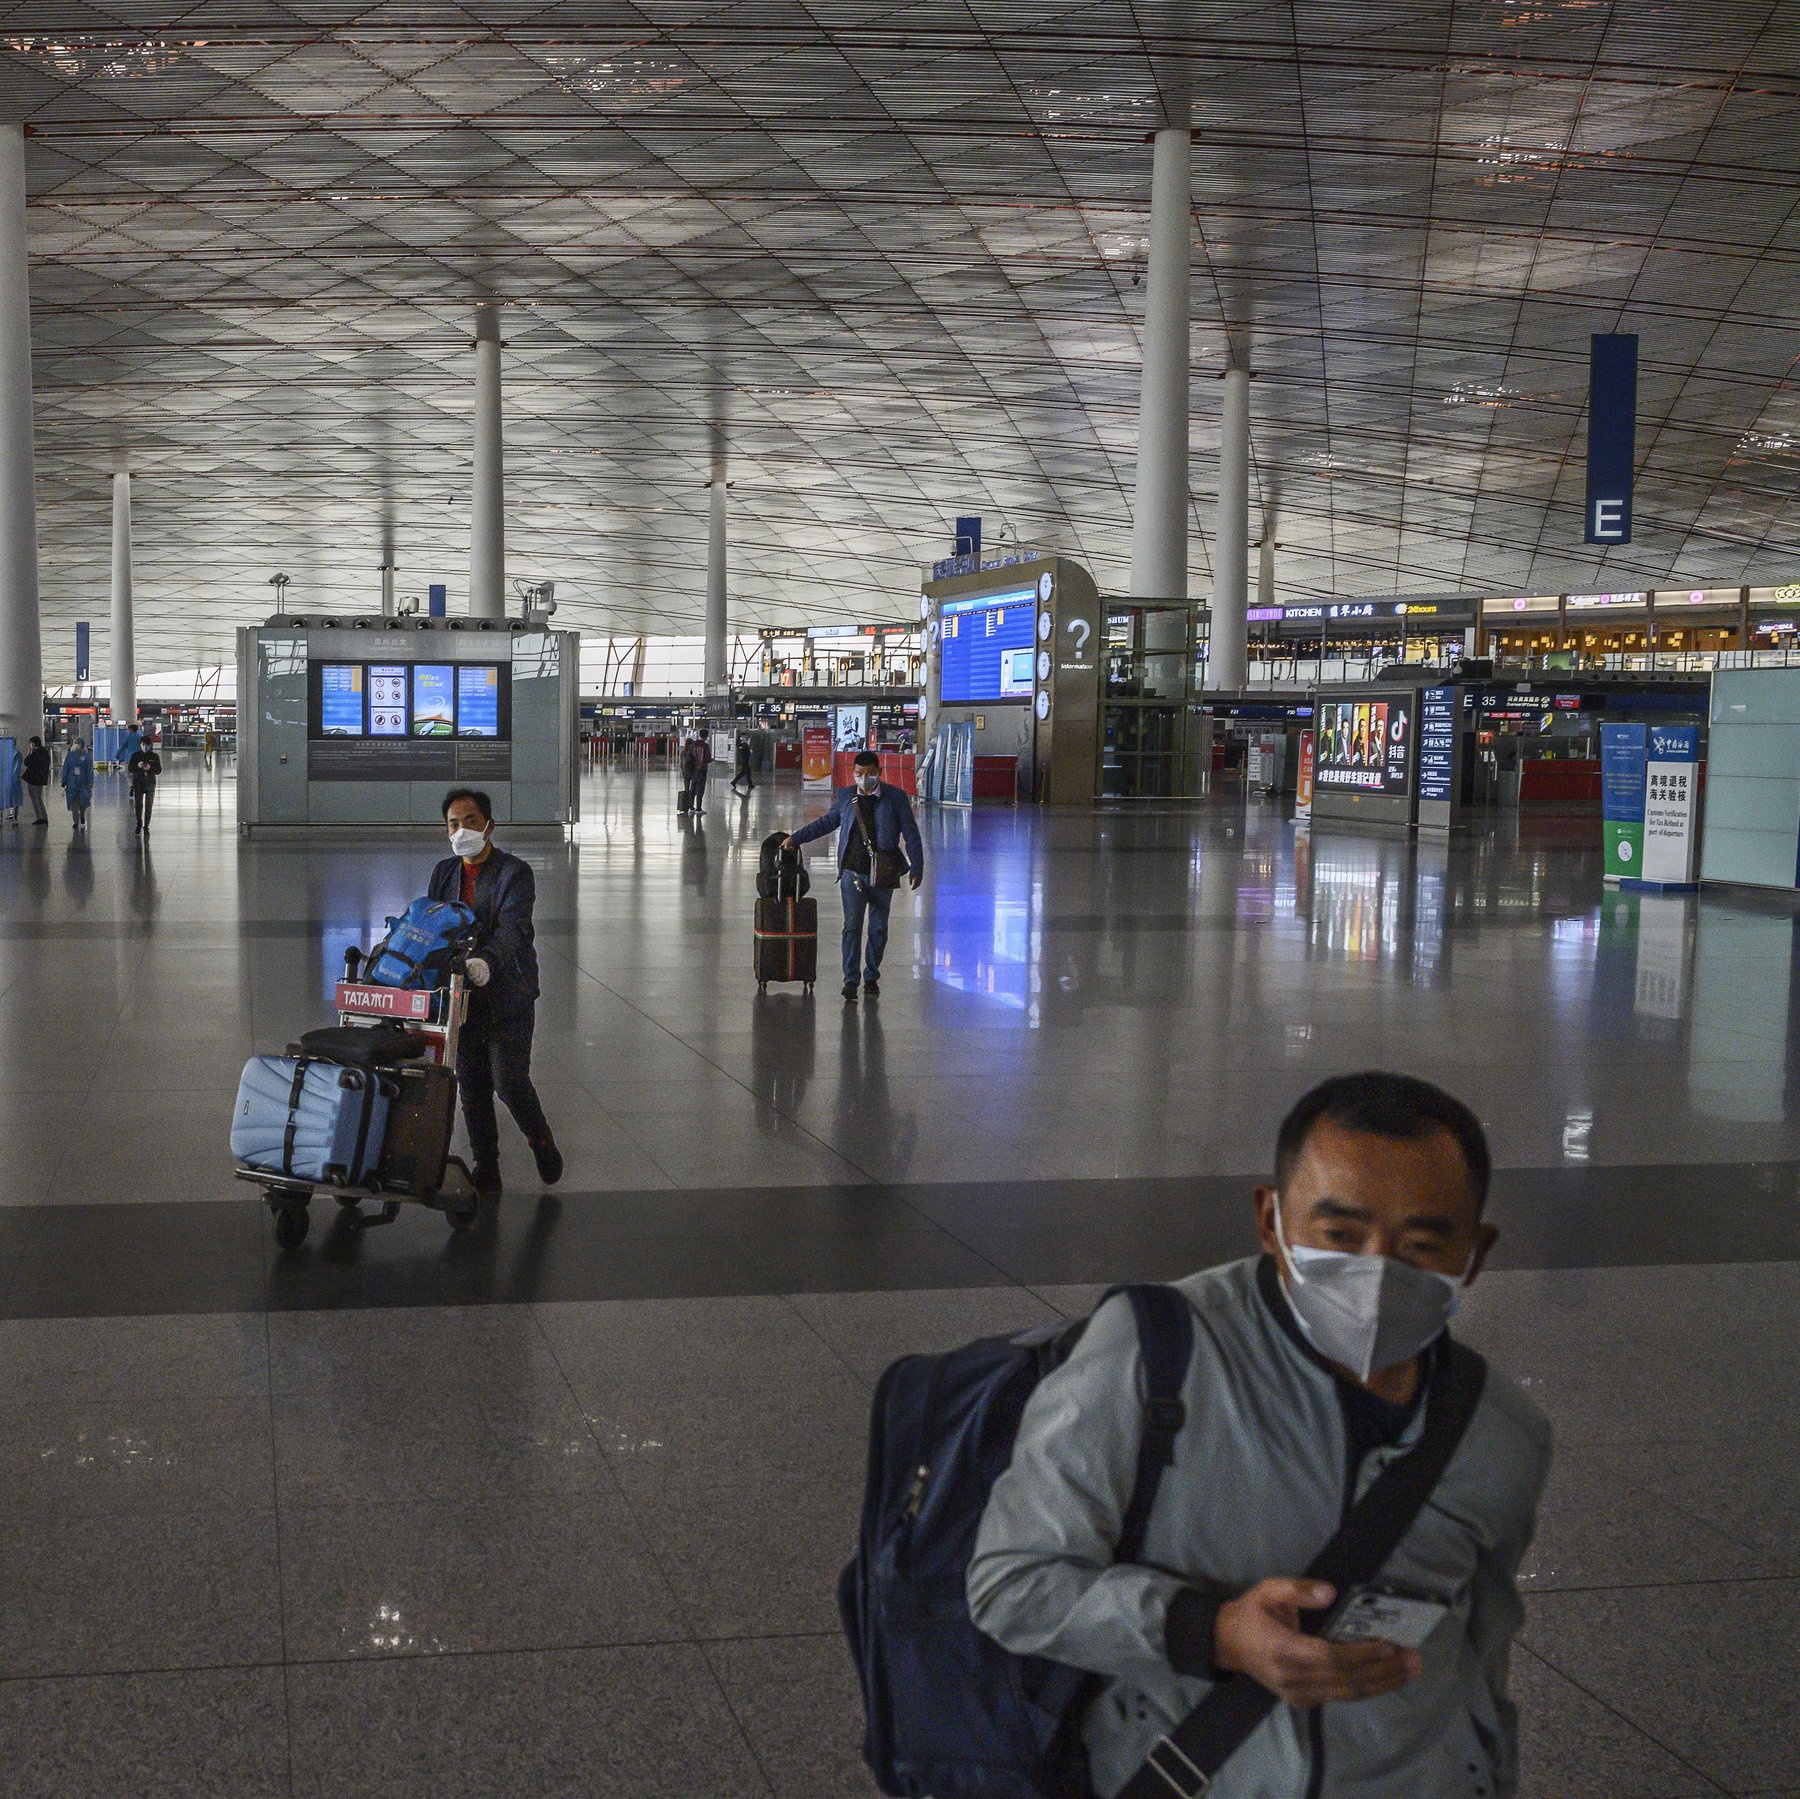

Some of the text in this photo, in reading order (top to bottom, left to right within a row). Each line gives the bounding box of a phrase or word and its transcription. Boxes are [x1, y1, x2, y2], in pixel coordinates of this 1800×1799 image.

[1594, 499, 1623, 537] E
[1285, 607, 1322, 618] KITCHEN
[79, 668, 86, 680] J
[1463, 694, 1496, 707] E 35
[758, 703, 781, 712] F 35
[1388, 744, 1405, 758] 抖音
[1650, 774, 1687, 788] 离境退税
[1649, 788, 1687, 802] 海关验核
[1664, 809, 1687, 818] Verification
[1664, 819, 1679, 827] Refund
